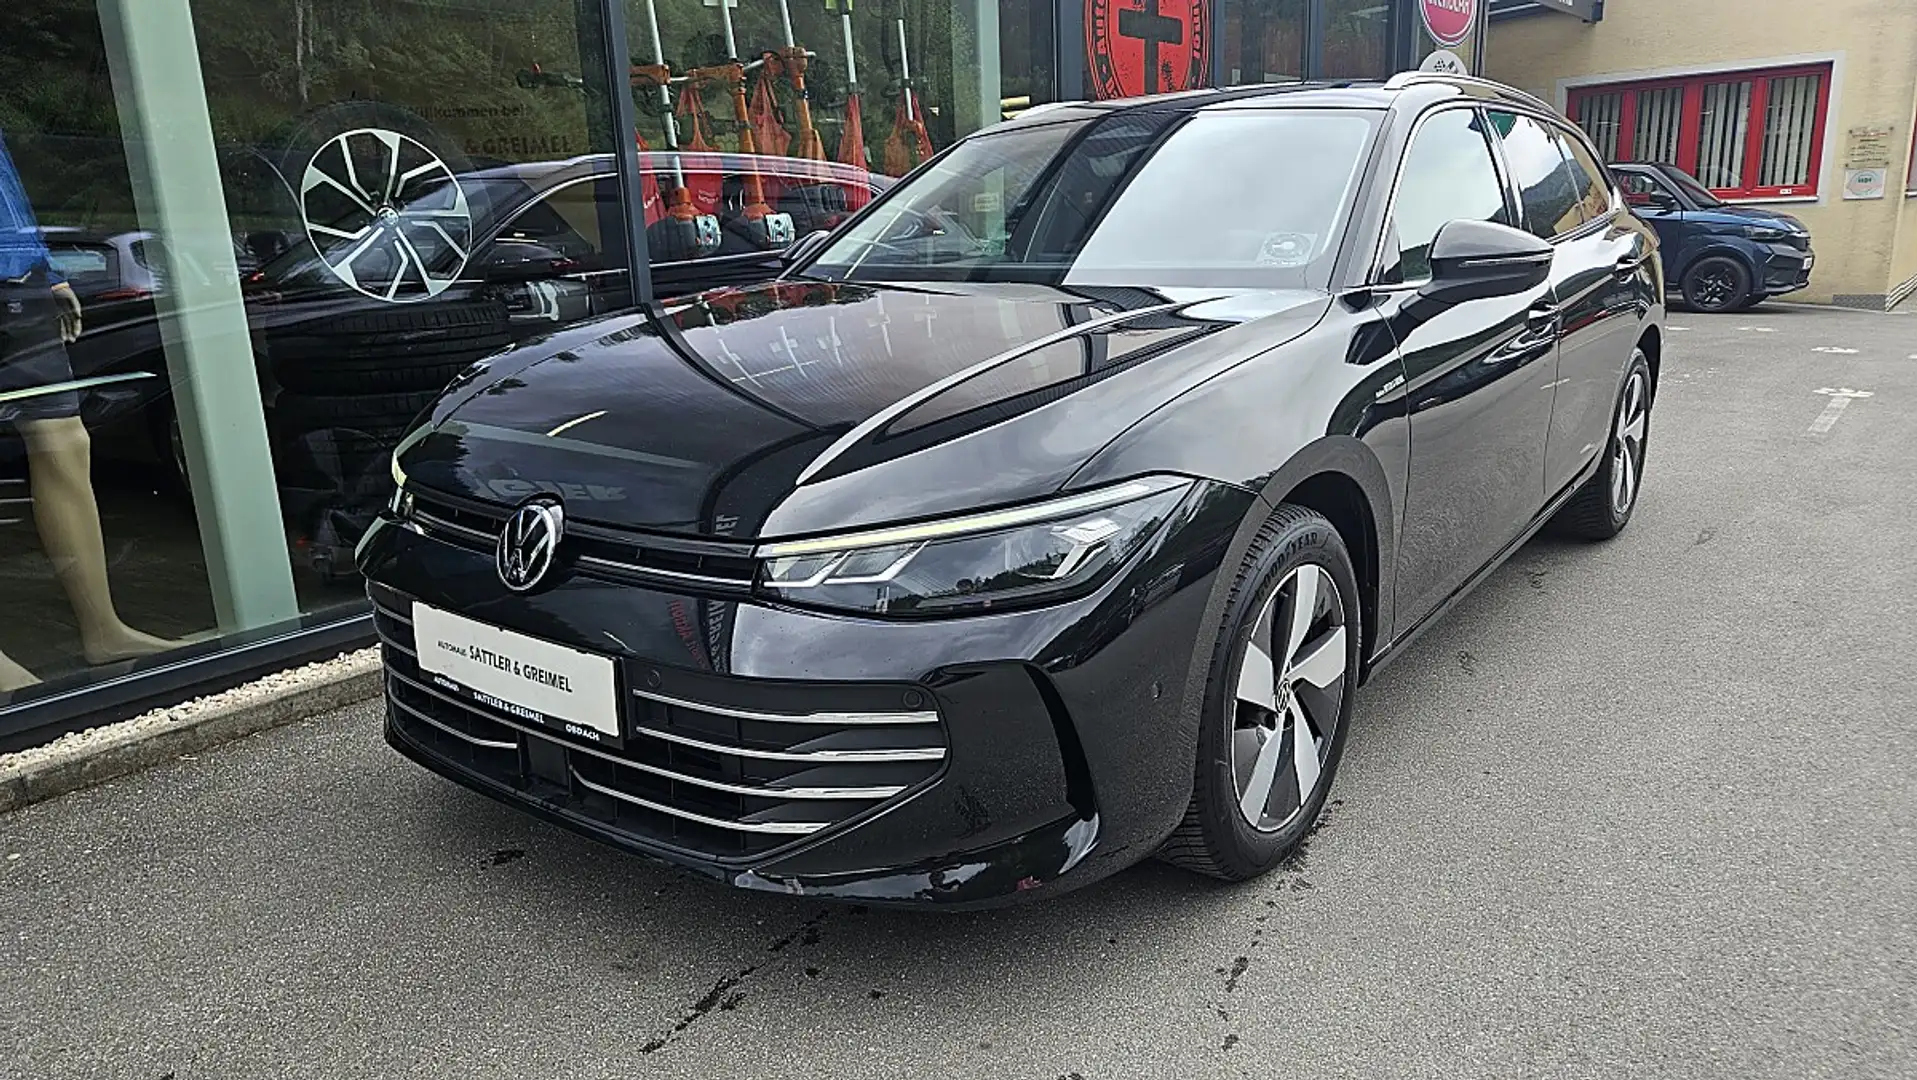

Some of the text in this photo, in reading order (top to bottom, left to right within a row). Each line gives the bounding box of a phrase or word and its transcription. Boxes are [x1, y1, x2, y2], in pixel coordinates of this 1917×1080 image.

[469, 645, 512, 673] SATTLER
[513, 660, 522, 676] &
[523, 664, 573, 693] GREIMEL
[510, 704, 545, 725] GREIMEL
